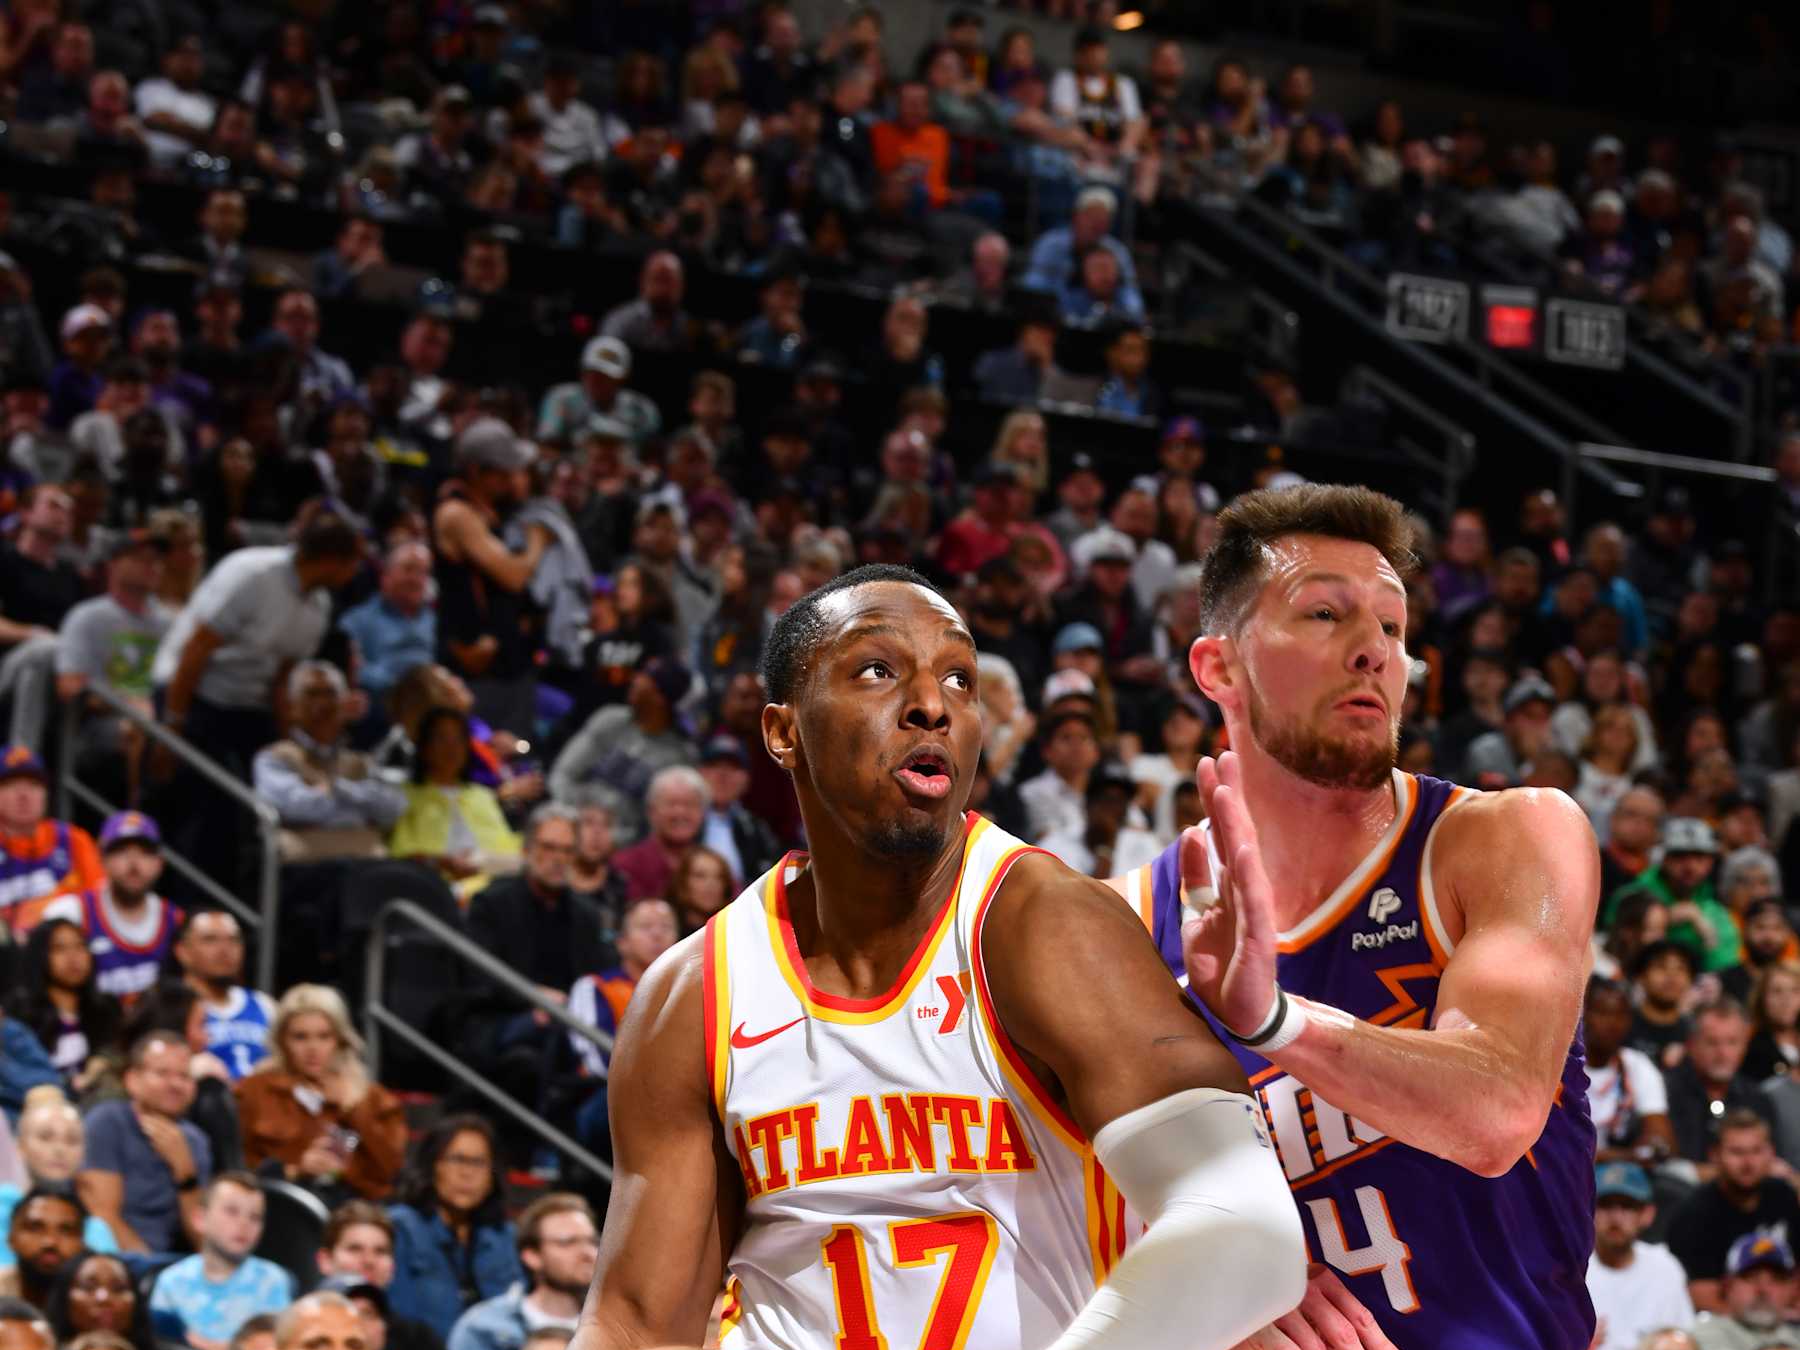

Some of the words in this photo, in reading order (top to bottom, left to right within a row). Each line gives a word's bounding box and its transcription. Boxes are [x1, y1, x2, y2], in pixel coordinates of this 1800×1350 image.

[1351, 920, 1418, 952] PayPal
[917, 1006, 939, 1019] the
[1304, 1184, 1421, 1314] 4
